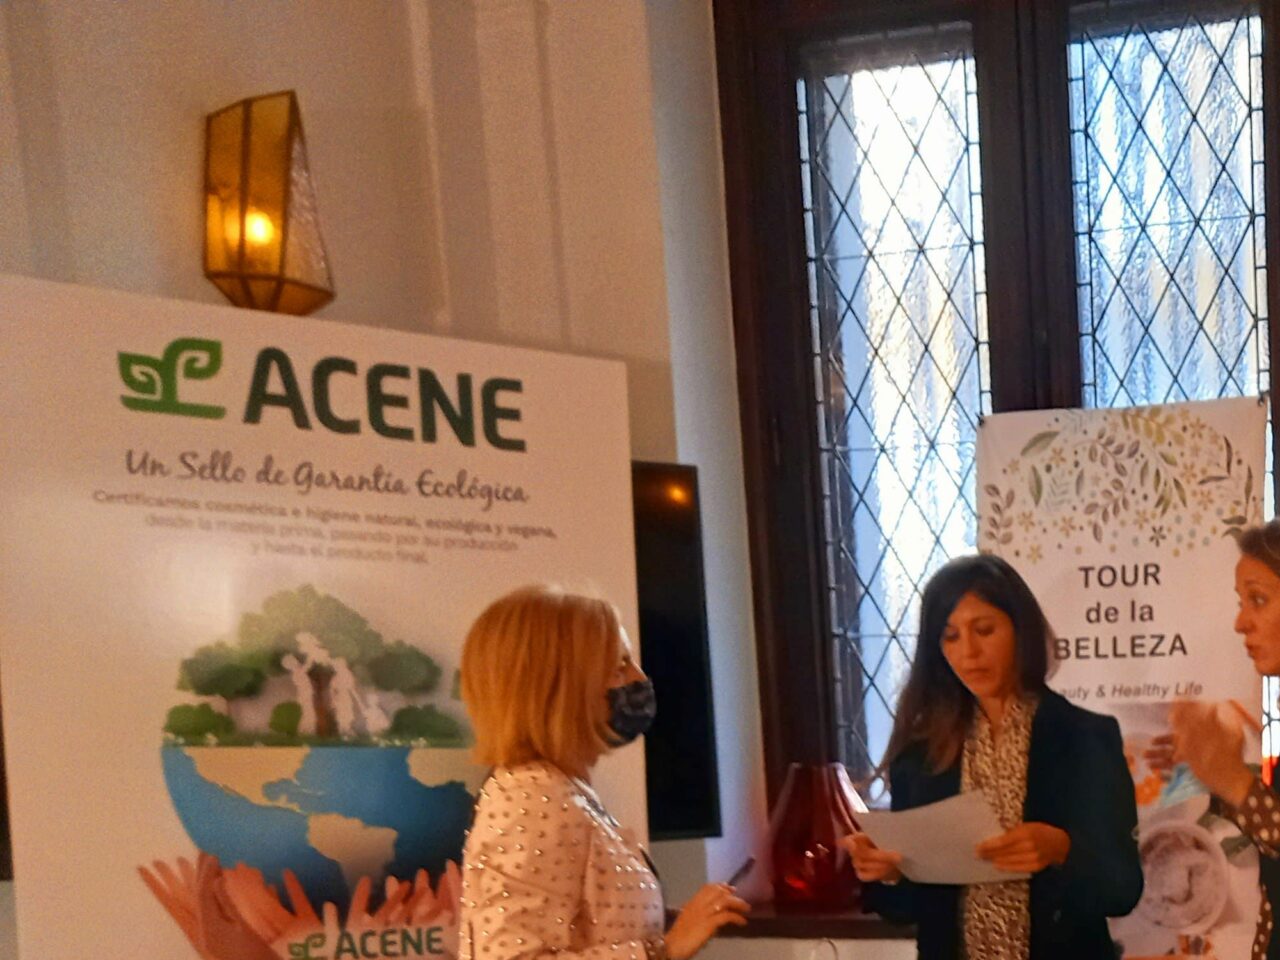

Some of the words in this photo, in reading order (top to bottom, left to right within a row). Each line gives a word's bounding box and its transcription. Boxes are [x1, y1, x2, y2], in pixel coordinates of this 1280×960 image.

[243, 346, 526, 451] ACENE
[126, 450, 170, 478] Un
[176, 450, 247, 484] Sello
[256, 454, 288, 486] de
[416, 468, 530, 512] Ecológica
[1078, 563, 1161, 588] TOUR
[1085, 602, 1119, 624] de
[1129, 599, 1155, 622] la
[1053, 634, 1188, 660] BELLEZA
[1095, 684, 1107, 698] &
[1111, 683, 1170, 700] Healthy
[1174, 681, 1203, 697] Life
[334, 926, 444, 960] ACENE
